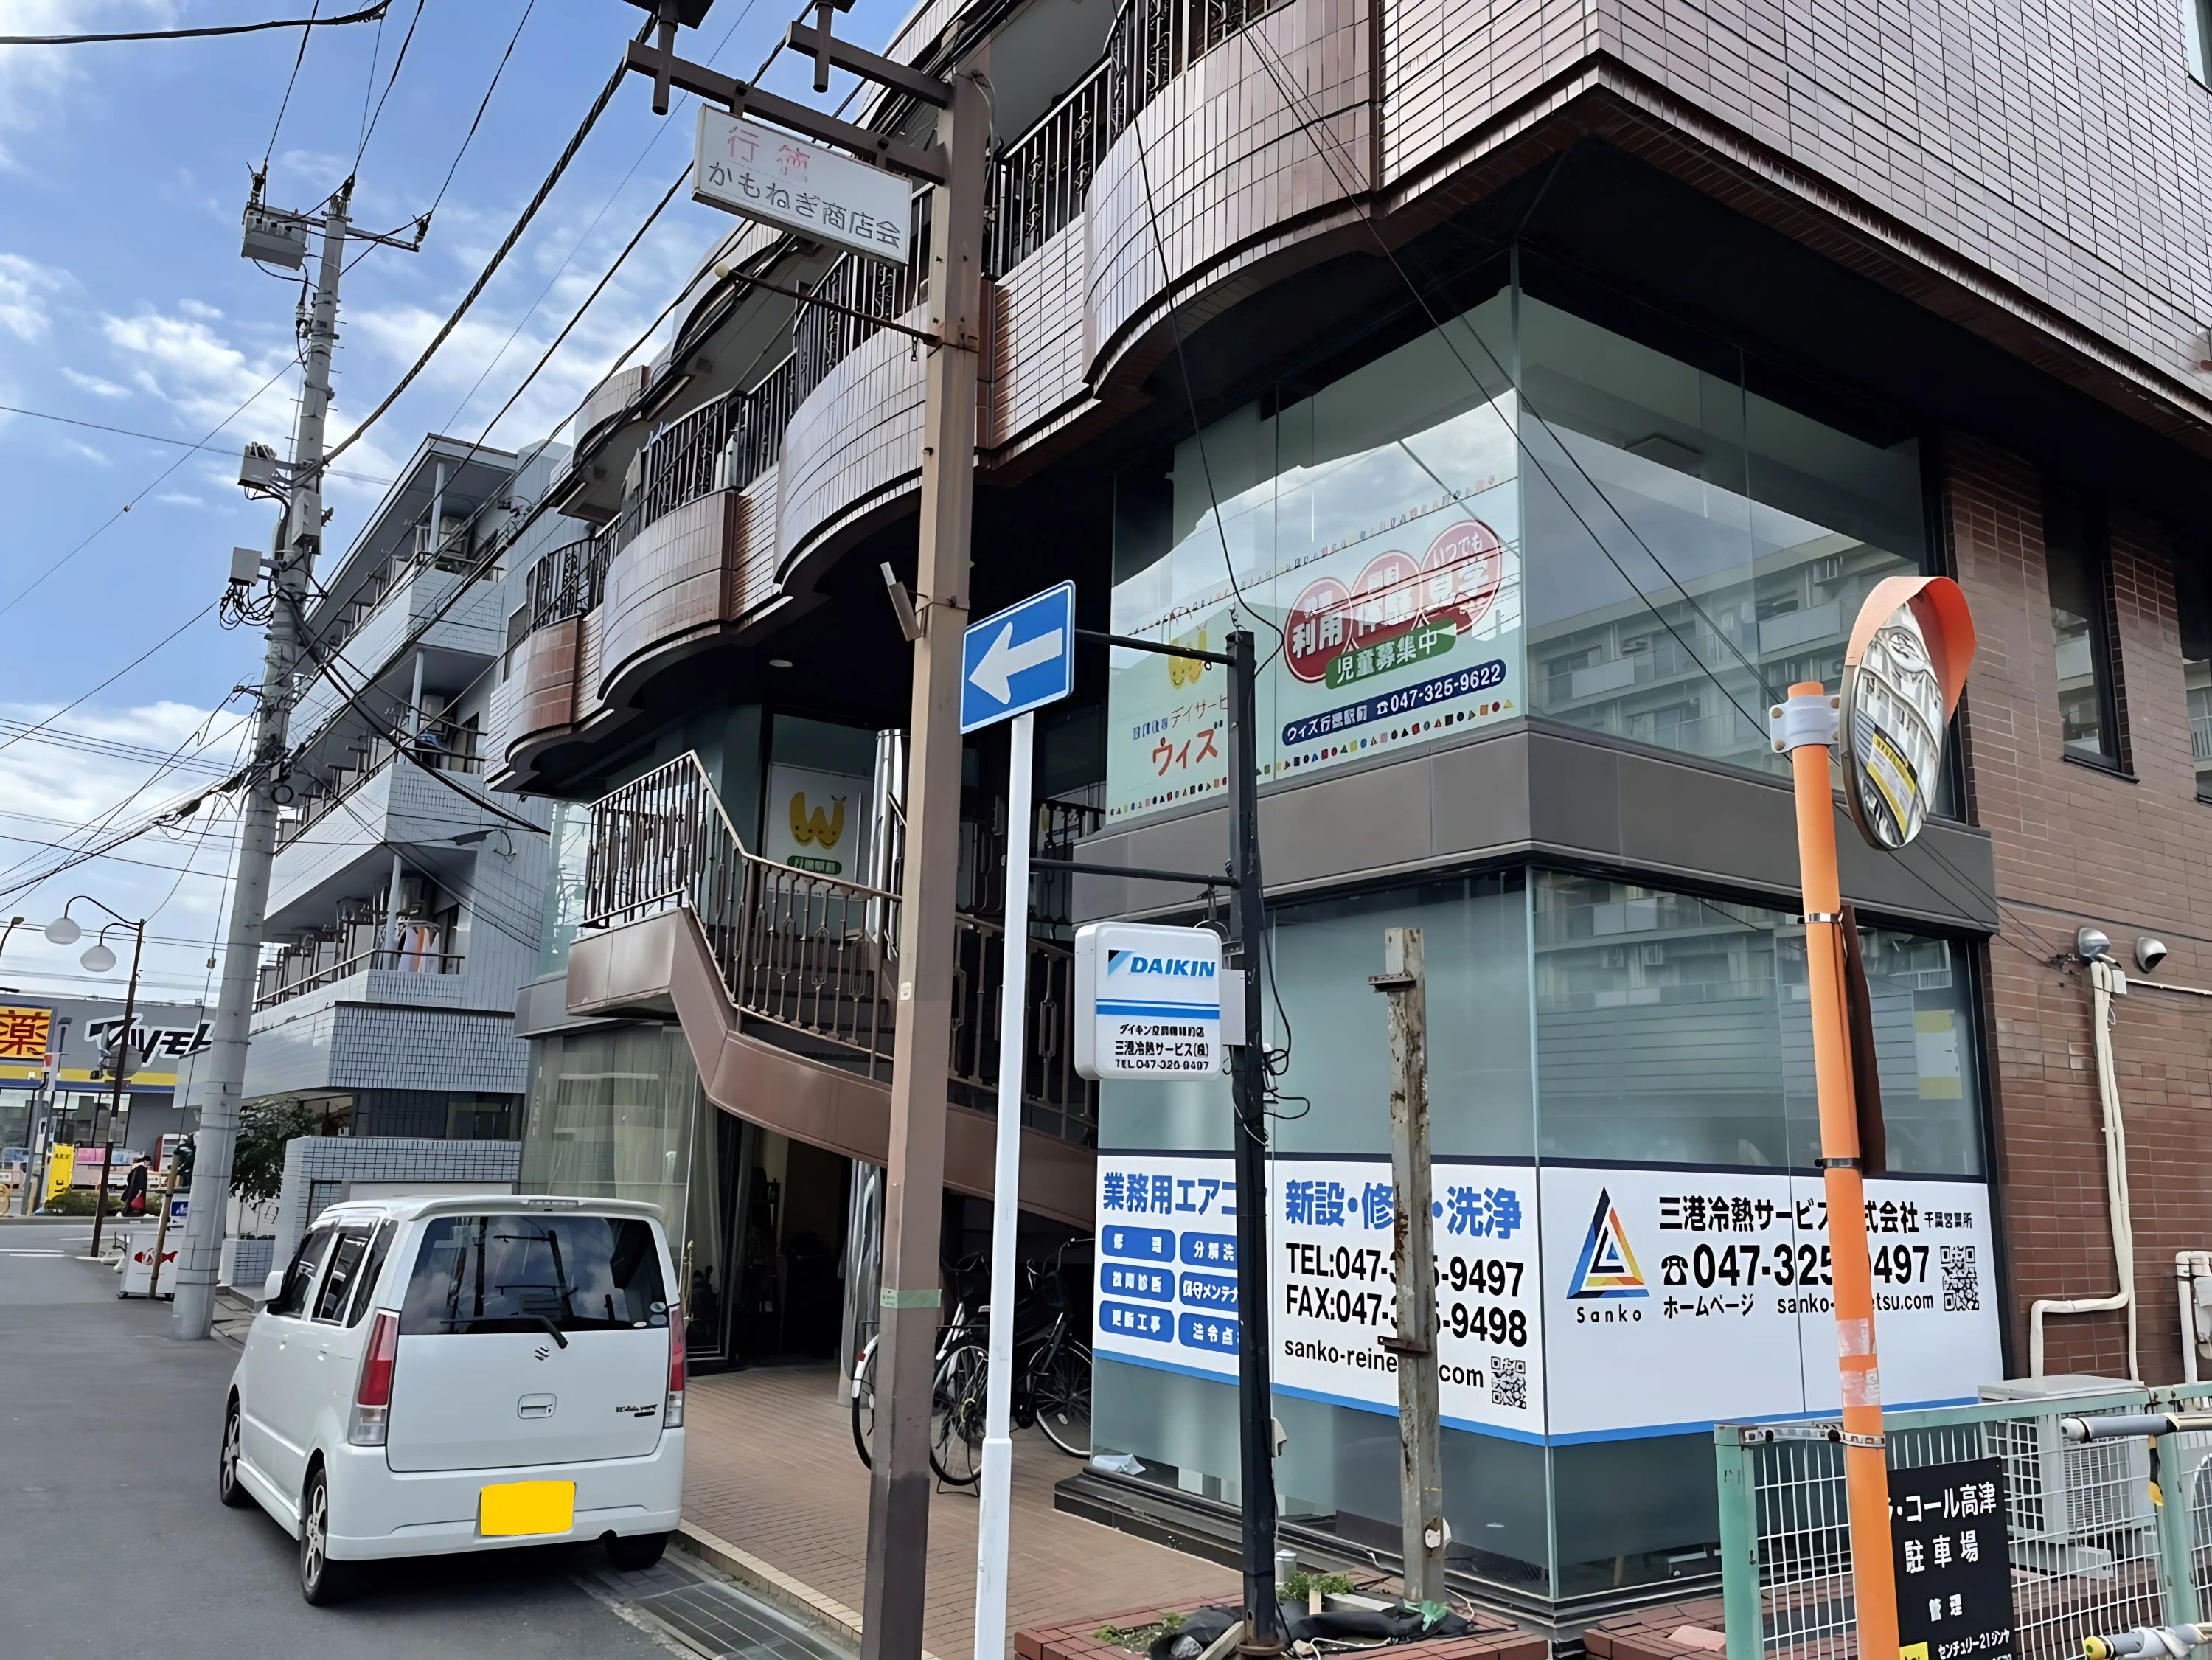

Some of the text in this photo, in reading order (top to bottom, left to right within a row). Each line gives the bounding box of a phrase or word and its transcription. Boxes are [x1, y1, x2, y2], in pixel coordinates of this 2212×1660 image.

[709, 162, 900, 249] かもねぎ商店会
[1293, 612, 1343, 659] 利用
[1391, 664, 1502, 712] 047-325-9622
[1152, 720, 1224, 776] ウィズ
[1130, 956, 1216, 977] DAIKIN
[0, 1009, 50, 1055] 薬
[1286, 1180, 1522, 1239] 新設・修・洗浄
[1659, 1195, 1919, 1234] 三港冷熱サービス式会社
[1286, 1243, 1524, 1297] TEL:047--9497
[1287, 1284, 1528, 1347] FAX:047--9498
[1577, 1303, 1641, 1324] Sanko
[1663, 1293, 1934, 1319] ホームページ sanko-tsu.com
[1193, 1322, 1239, 1345] 法令点
[1284, 1339, 1484, 1387] sanko-reinecom
[1905, 1529, 1979, 1574] 駐車場
